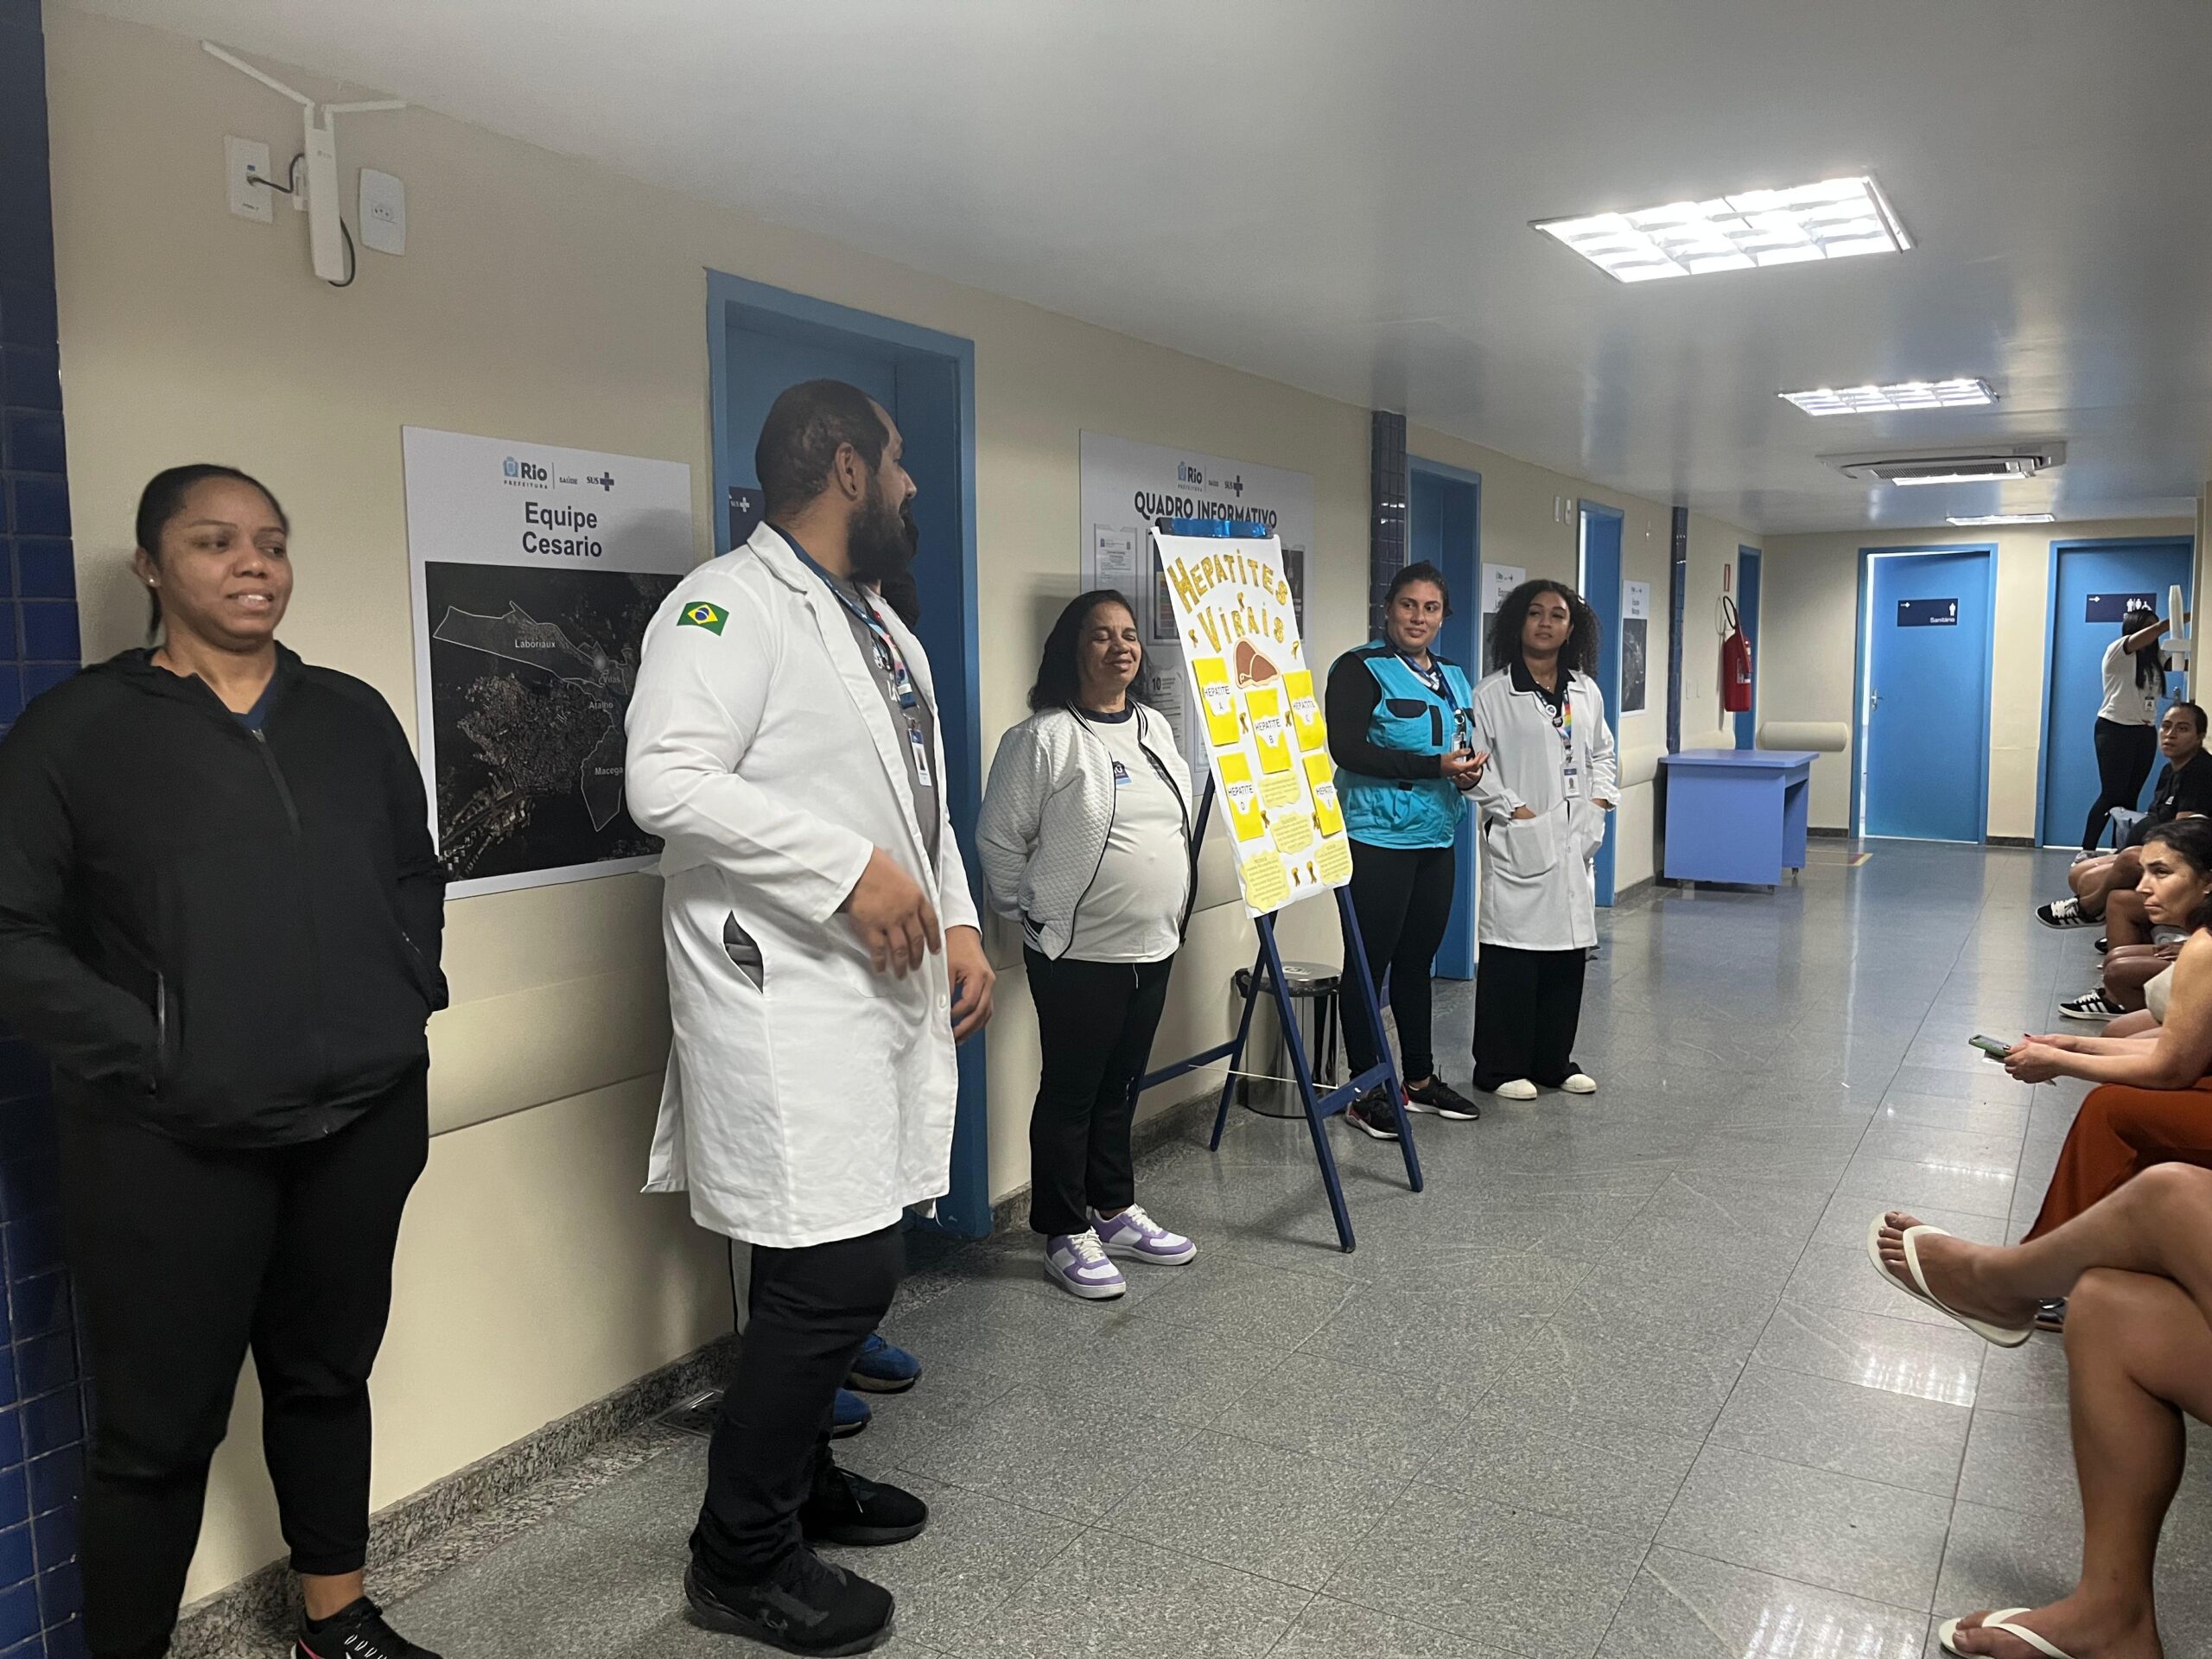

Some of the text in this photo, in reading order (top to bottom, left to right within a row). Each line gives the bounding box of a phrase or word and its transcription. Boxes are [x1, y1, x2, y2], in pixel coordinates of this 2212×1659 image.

[520, 462, 548, 481] Rio
[1187, 467, 1203, 484] Rio
[504, 480, 548, 490] PREFEITURA
[586, 476, 600, 485] SUS
[524, 501, 598, 533] Equipe
[1135, 491, 1278, 530] QUADRO INFORMATIVO
[522, 531, 602, 557] Cesario
[1152, 677, 1162, 691] 10
[1204, 685, 1230, 698] HEPATITE
[1219, 702, 1224, 710] A
[1255, 718, 1281, 731] HEPATITE
[1269, 735, 1274, 744] B
[1228, 785, 1254, 796] HEPATITE
